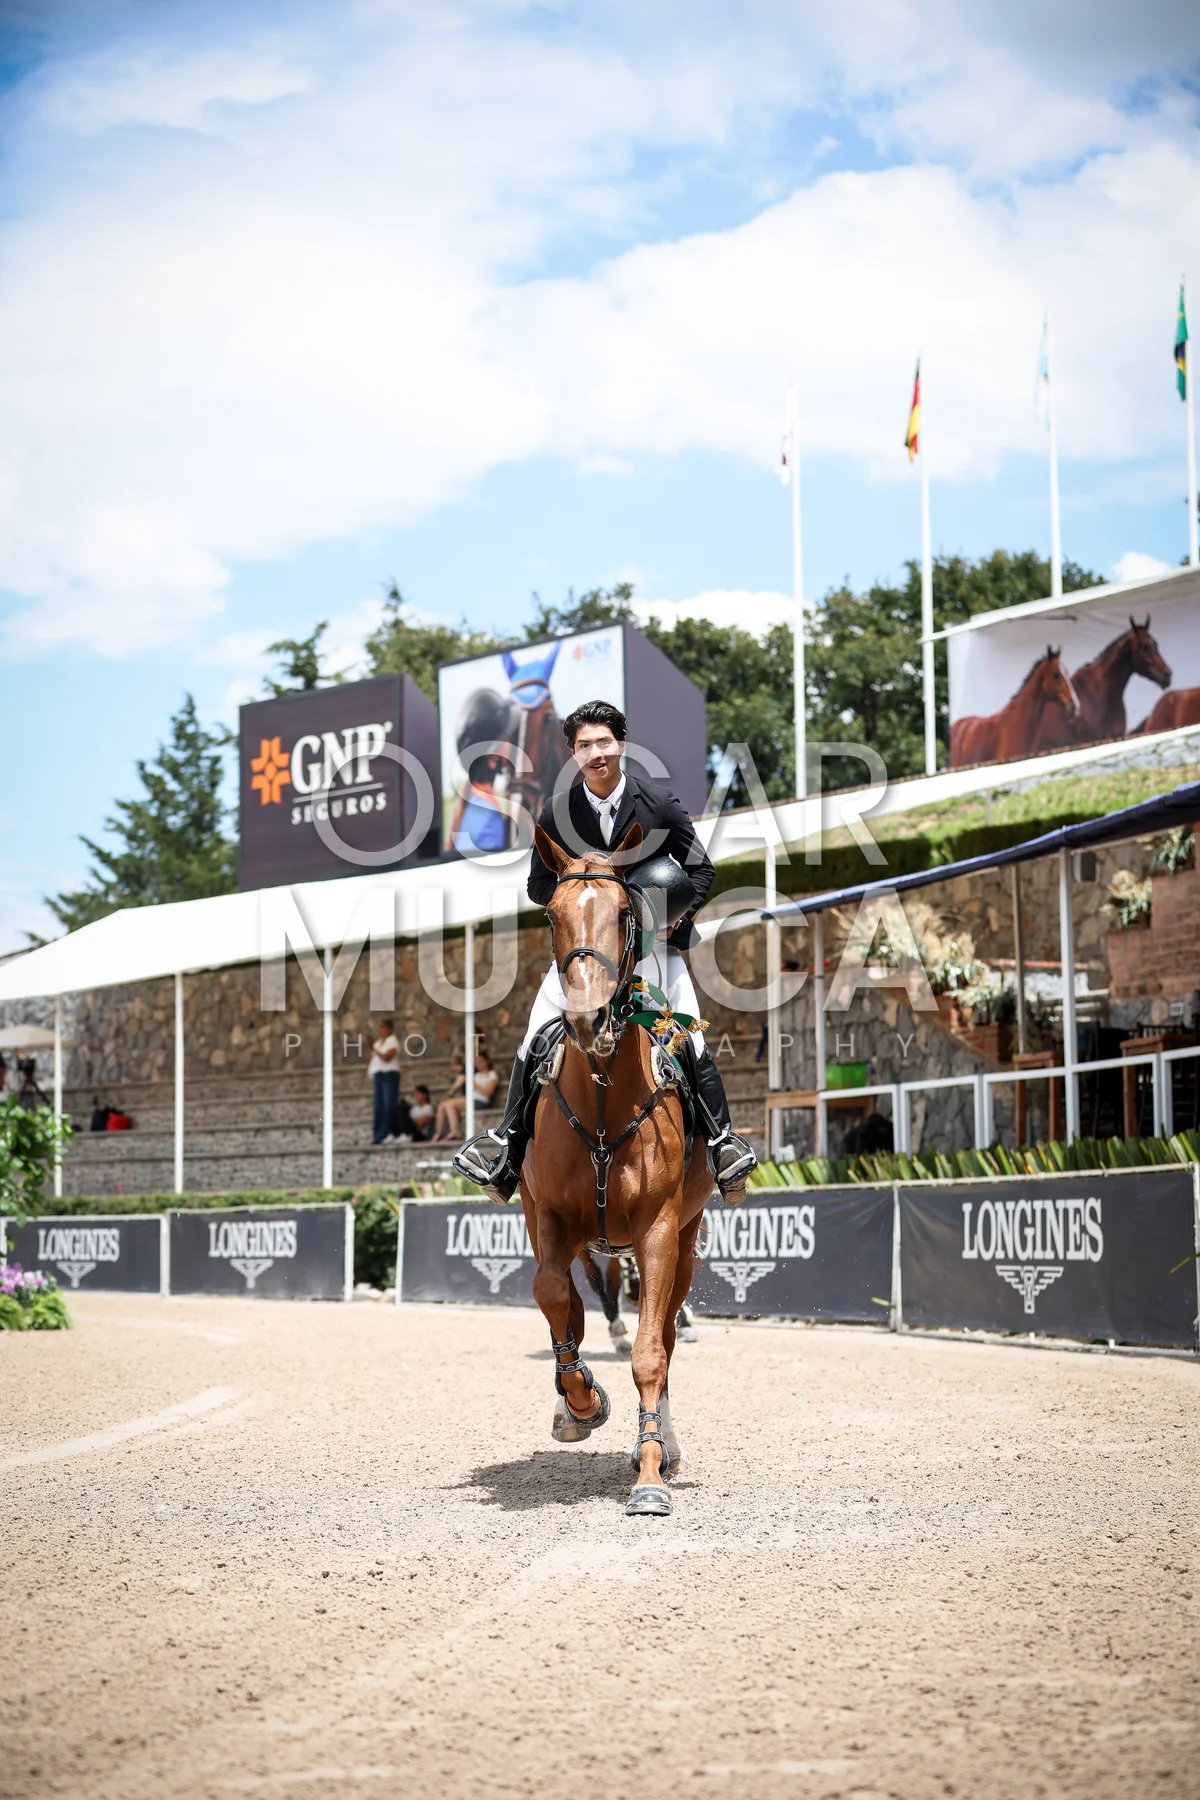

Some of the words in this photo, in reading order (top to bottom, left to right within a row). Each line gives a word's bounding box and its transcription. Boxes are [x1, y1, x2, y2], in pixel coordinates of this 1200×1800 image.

[291, 724, 386, 794] GNP
[291, 792, 387, 825] SEGUROS
[37, 1228, 120, 1262] LONGINES
[208, 1220, 297, 1258] LONGINES
[695, 1205, 816, 1260] ONGINES
[962, 1197, 1103, 1263] LONGINES
